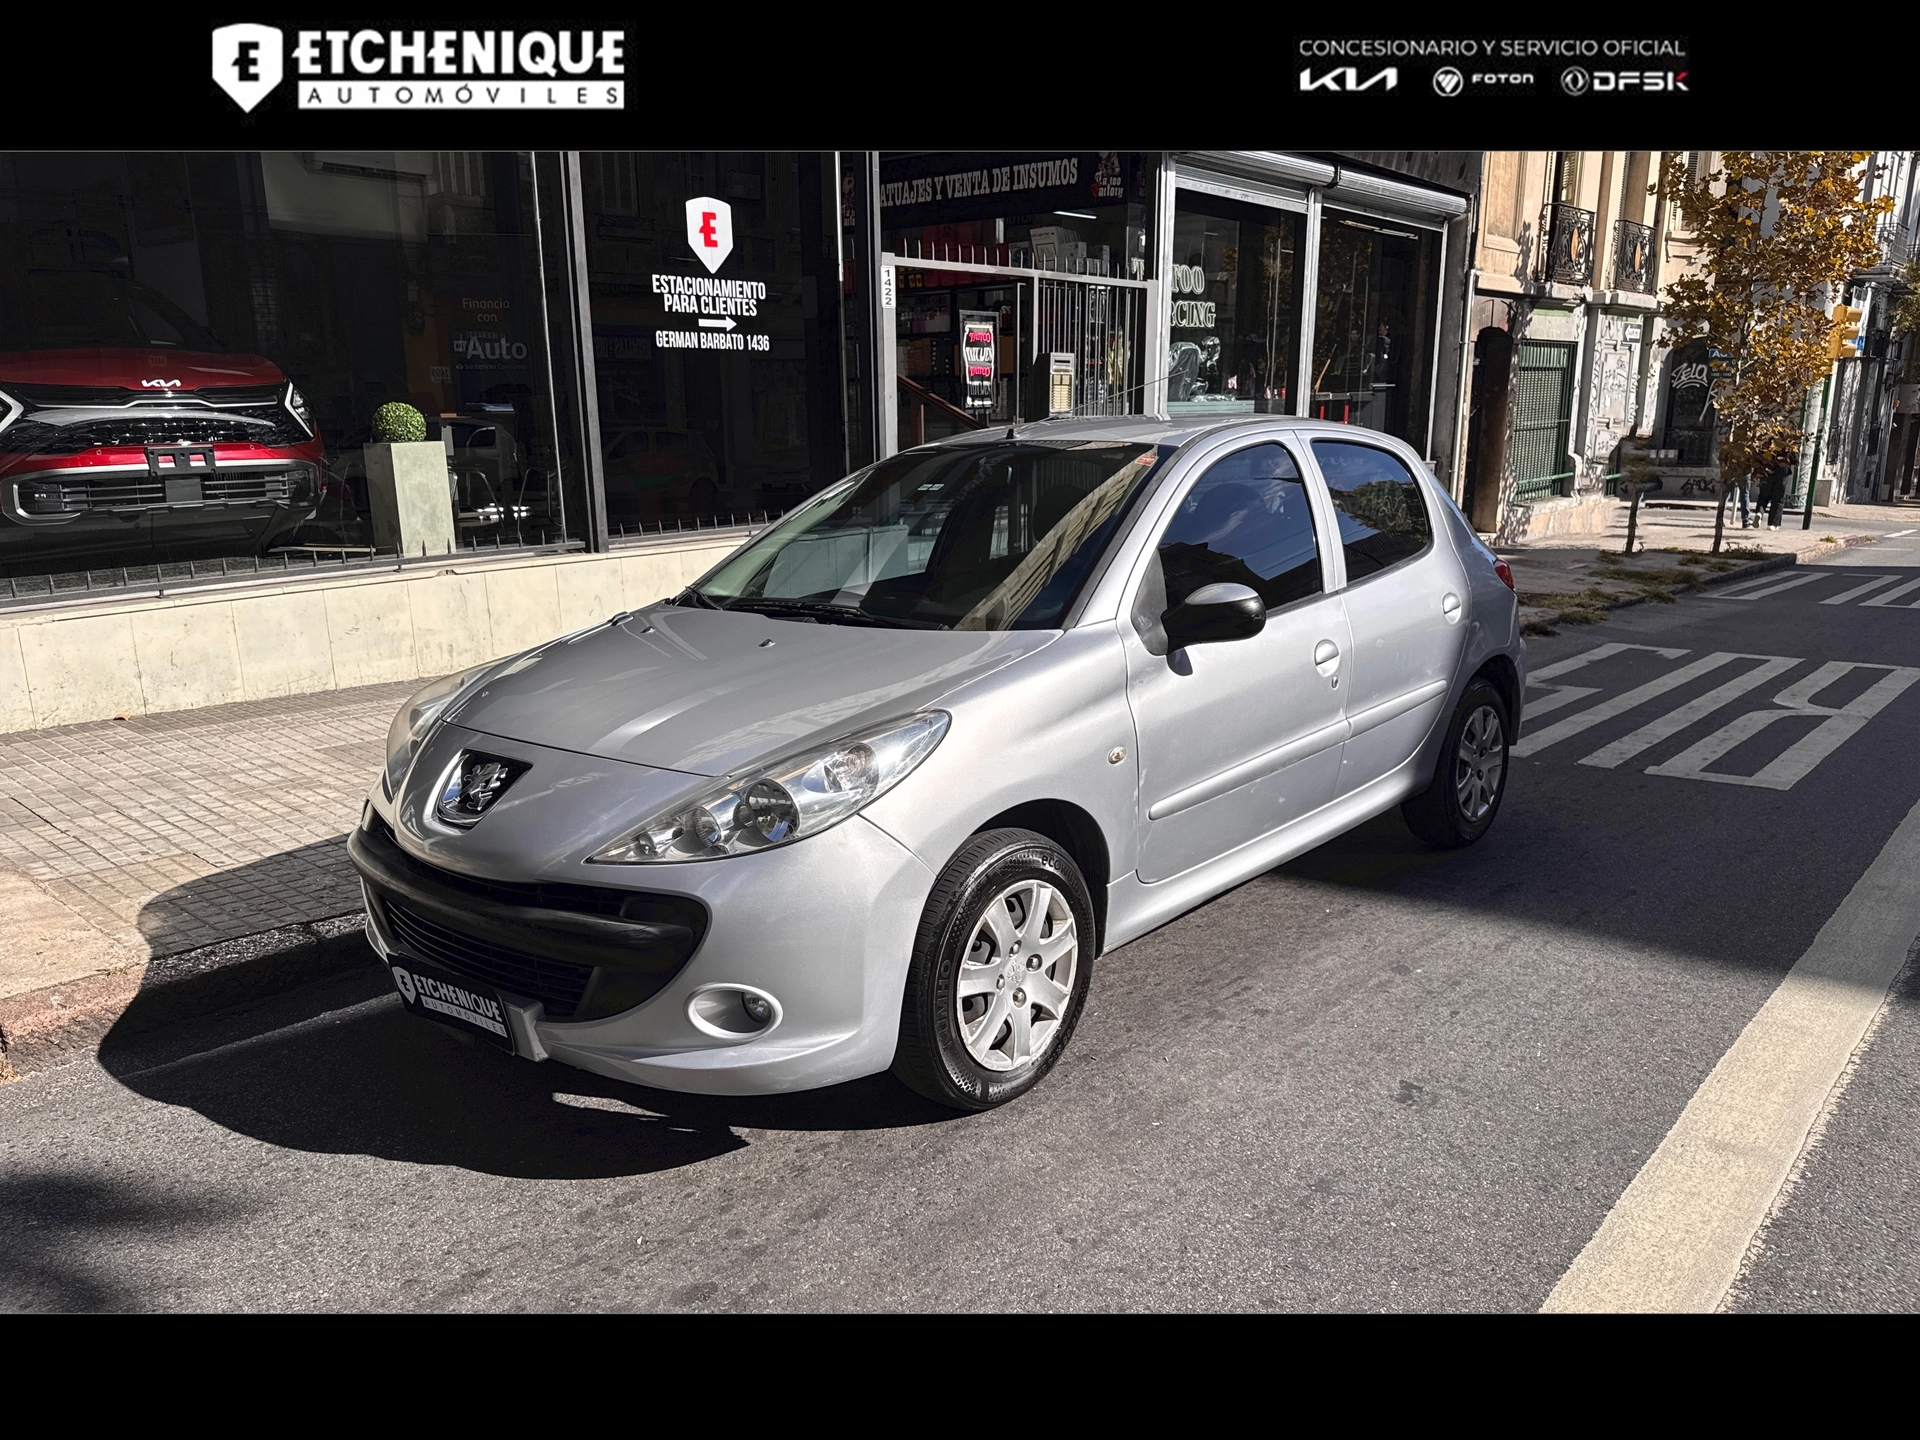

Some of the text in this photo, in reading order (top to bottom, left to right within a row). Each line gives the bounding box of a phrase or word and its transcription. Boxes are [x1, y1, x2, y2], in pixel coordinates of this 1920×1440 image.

[880, 157, 1078, 207] ATUAJES Y VENTA DE INSUMOS
[652, 273, 767, 300] ESTACIONAMIENTO
[884, 268, 893, 306] 1422
[462, 298, 510, 309] Financia
[663, 293, 758, 317] PARA CLIENTES
[477, 314, 498, 323] con
[466, 336, 528, 360] Auto
[655, 330, 699, 349] GERMAN
[700, 332, 744, 350] BARBATO
[746, 334, 770, 351] 1436
[464, 362, 497, 370] Santander
[141, 379, 182, 387] KIA
[412, 974, 503, 1022] ETCHENIQUE
